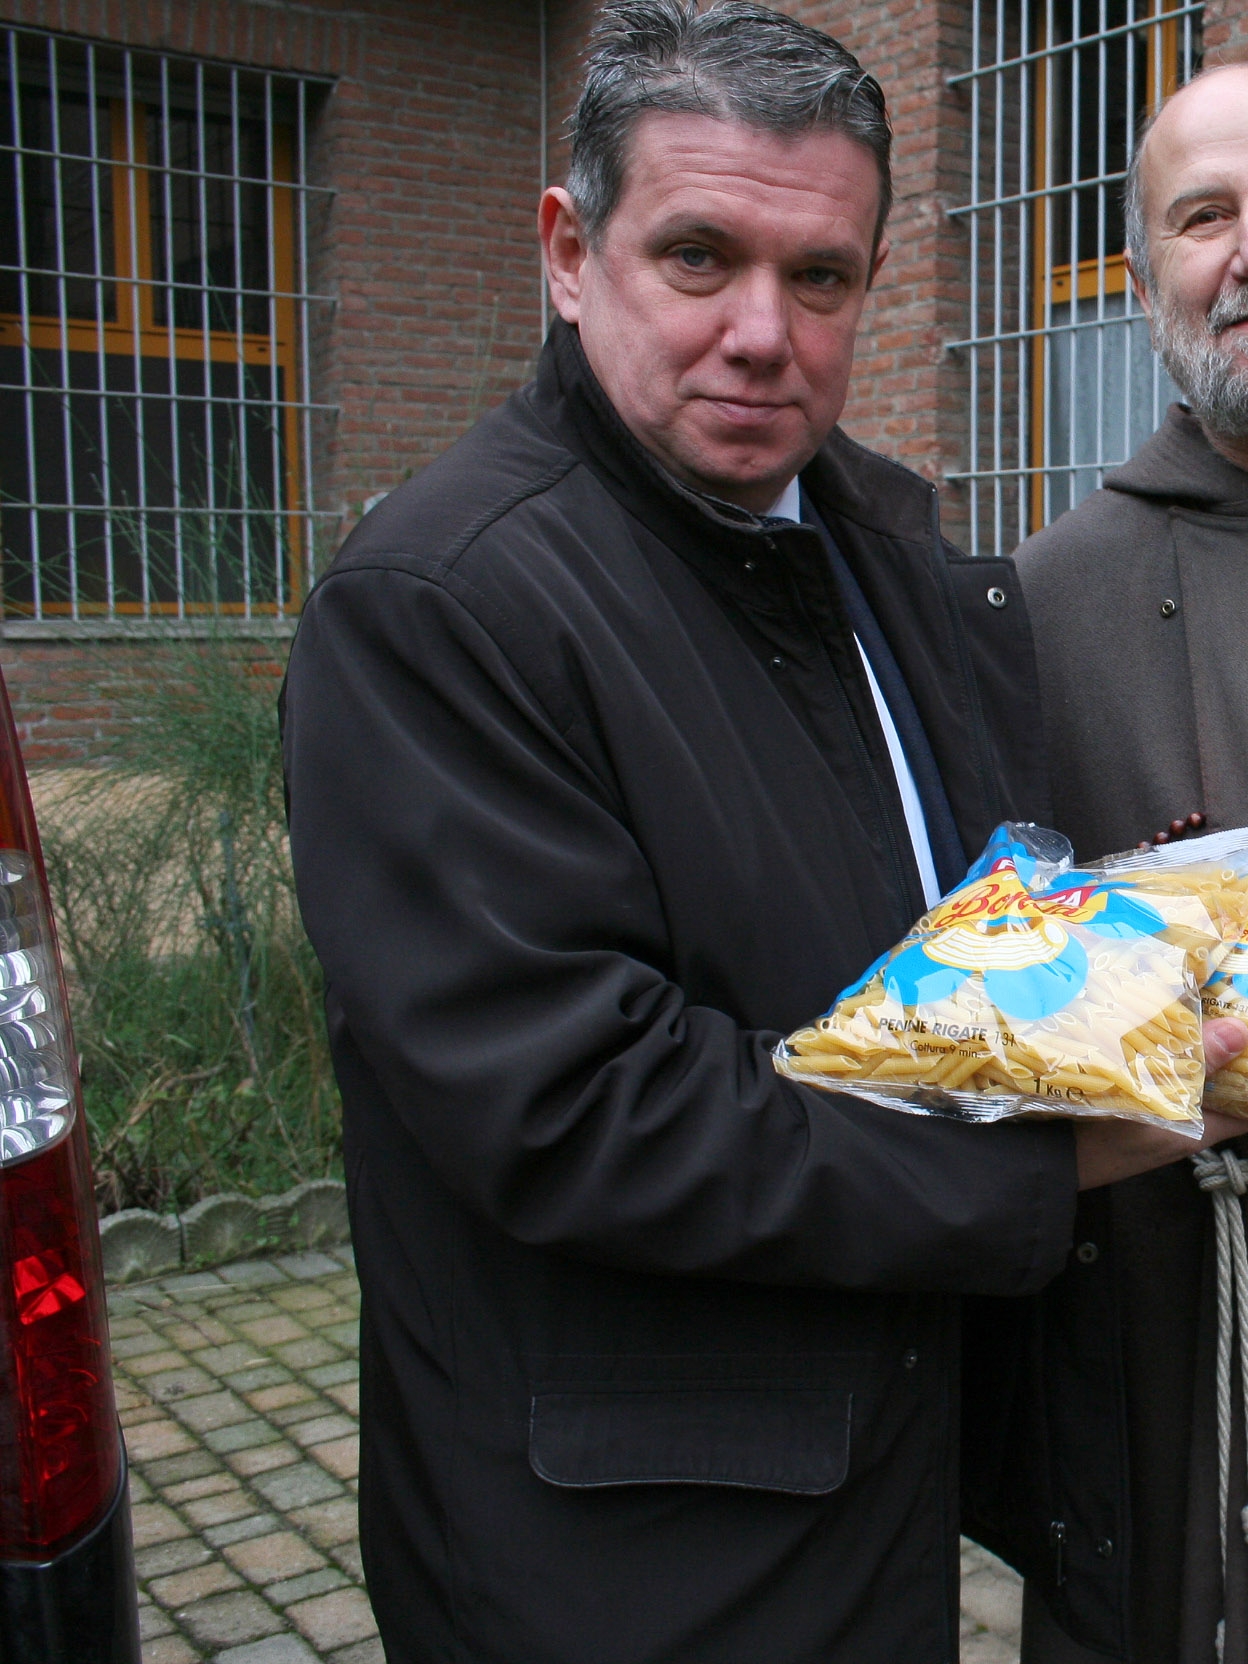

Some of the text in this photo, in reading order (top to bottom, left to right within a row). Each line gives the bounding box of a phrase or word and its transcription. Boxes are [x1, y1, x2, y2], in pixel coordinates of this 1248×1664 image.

[1202, 997, 1232, 1009] RIGATE
[879, 1017, 1016, 1047] PENNE RIGATE 131
[910, 1040, 946, 1054] Cottura
[949, 1044, 957, 1054] 9
[1034, 1078, 1042, 1094] 1
